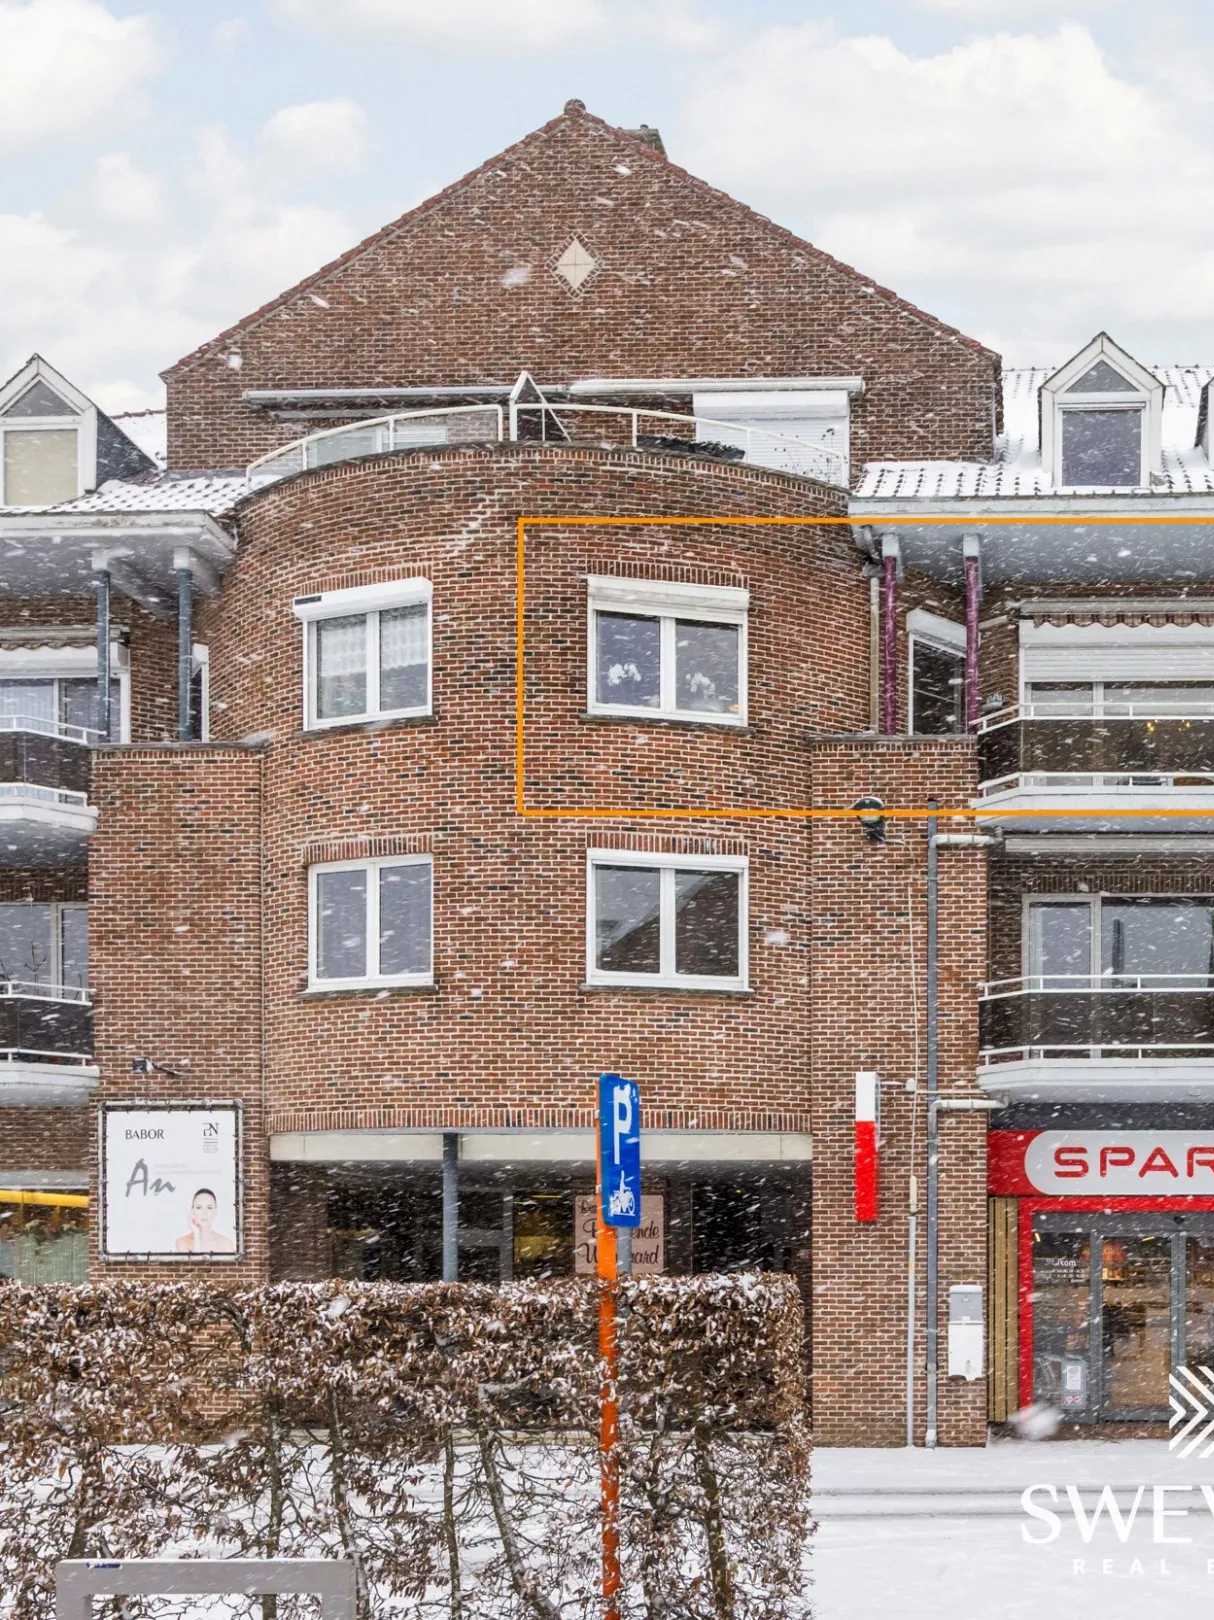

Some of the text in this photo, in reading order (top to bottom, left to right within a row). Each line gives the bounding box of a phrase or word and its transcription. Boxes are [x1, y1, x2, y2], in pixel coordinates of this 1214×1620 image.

[125, 1129, 165, 1140] BABOR
[613, 1084, 633, 1165] P
[125, 1158, 176, 1198] An
